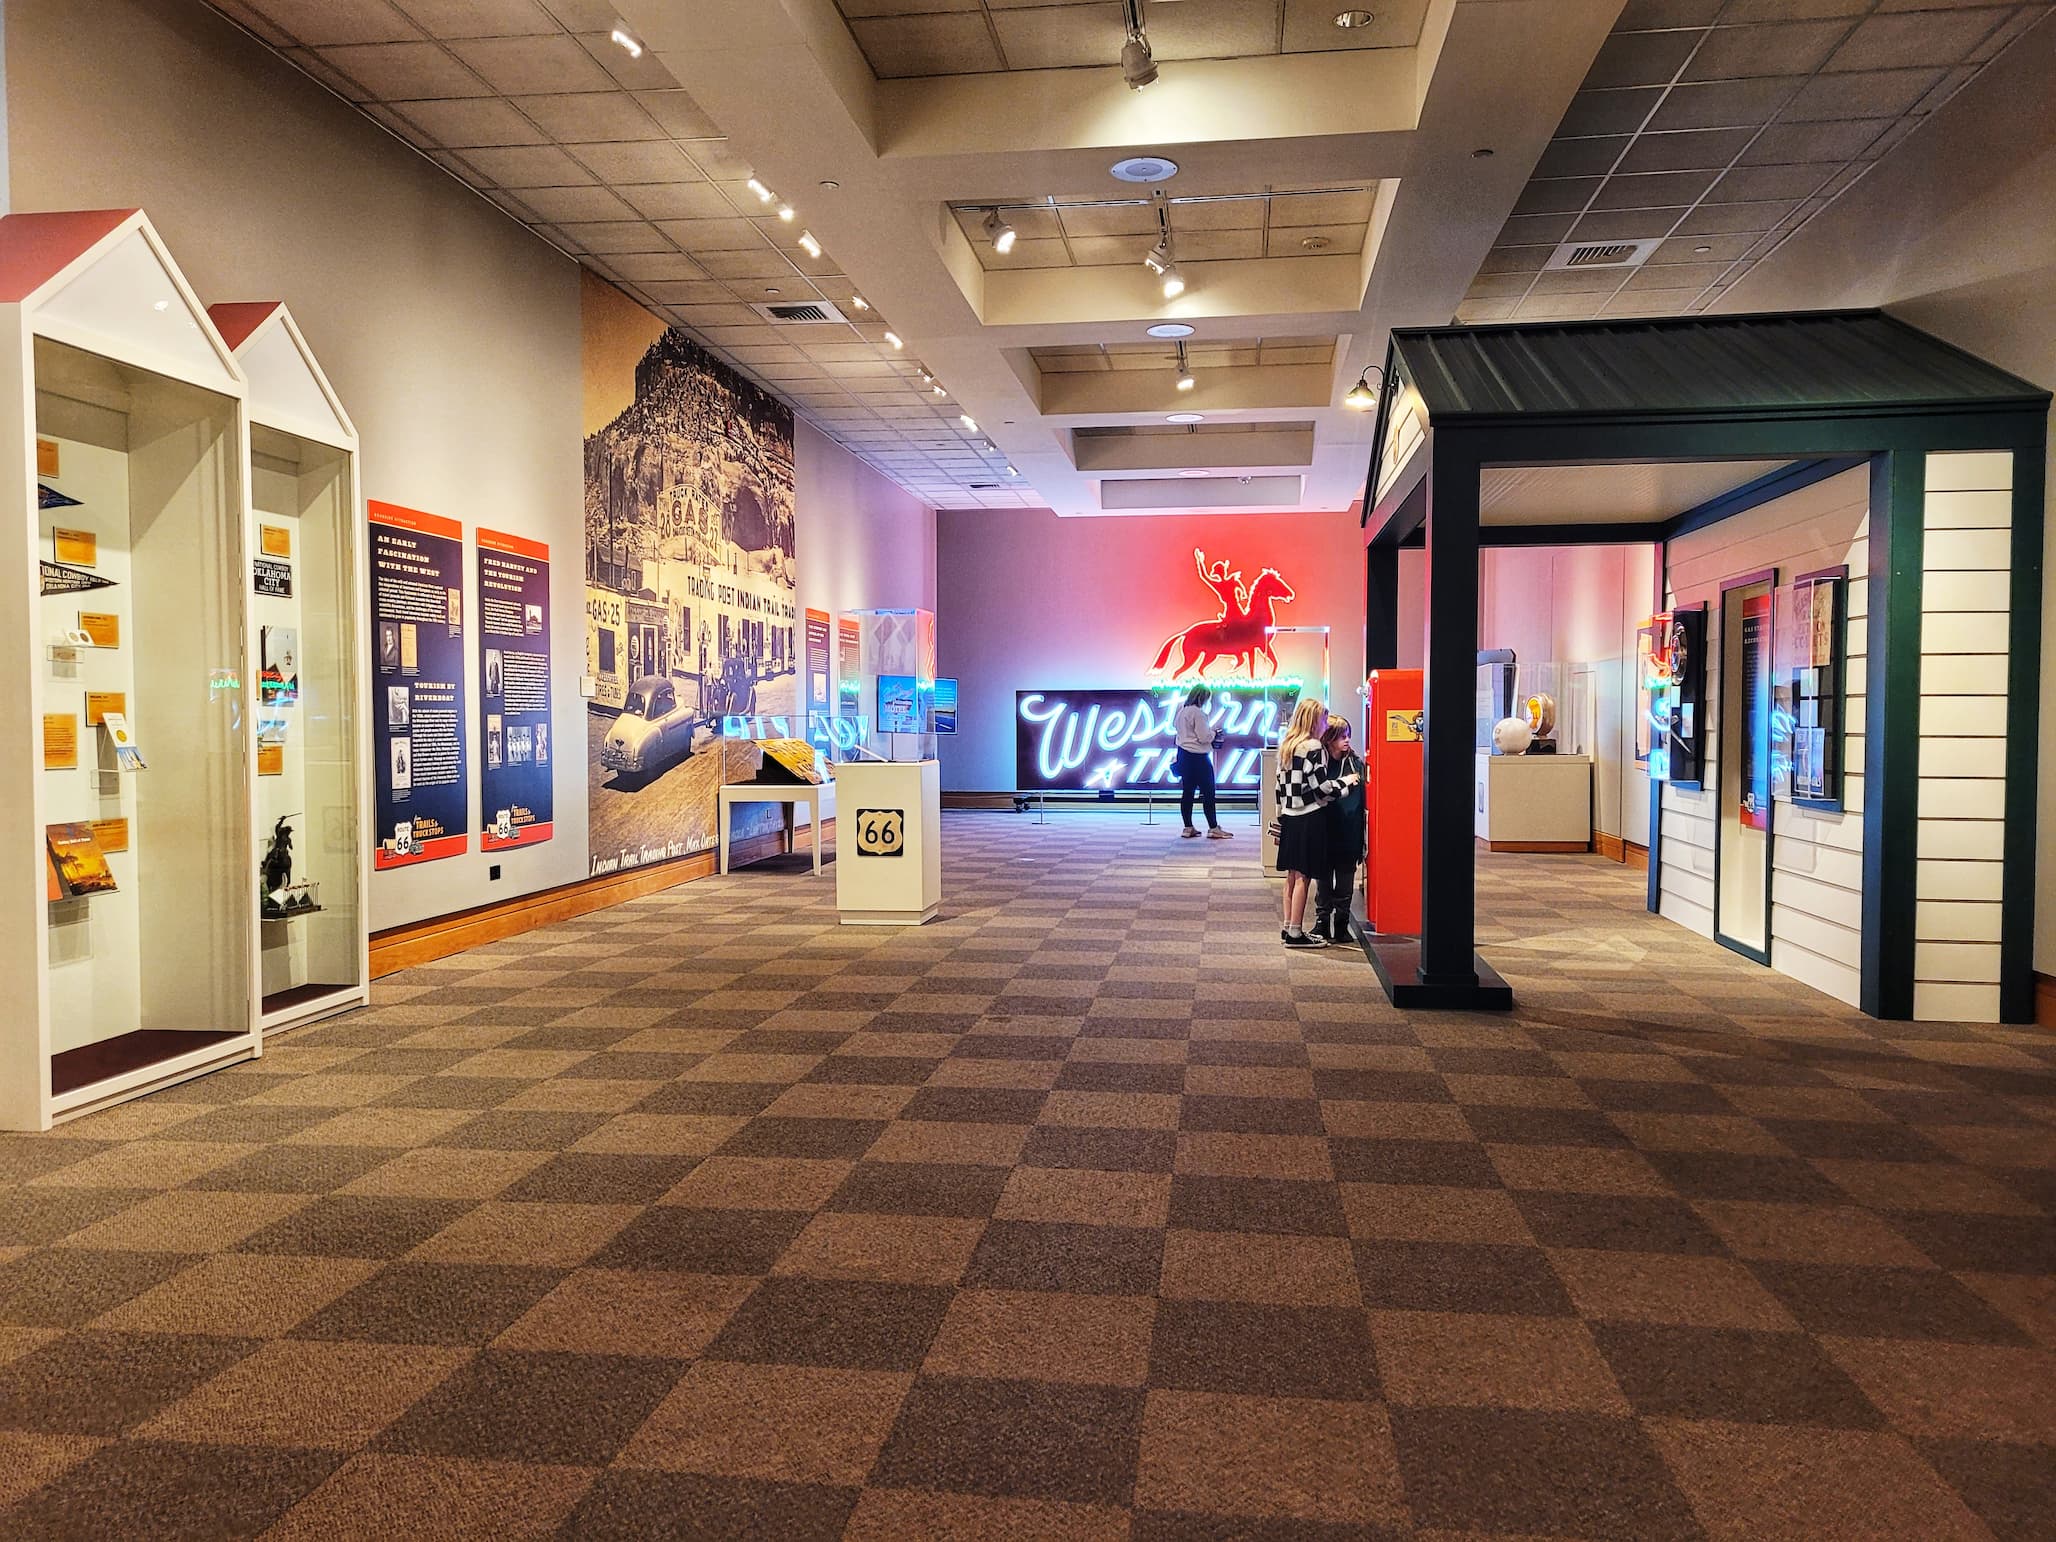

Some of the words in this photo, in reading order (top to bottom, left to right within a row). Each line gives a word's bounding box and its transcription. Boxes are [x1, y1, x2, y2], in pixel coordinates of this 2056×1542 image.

[672, 499, 709, 535] GAS
[377, 535, 390, 543] AN
[391, 537, 417, 549] EARLY
[377, 547, 430, 563] FASCINATION
[254, 566, 290, 580] OKLAHOMA
[377, 560, 402, 571] WITH
[402, 564, 418, 574] THE
[419, 567, 440, 577] WEST
[483, 557, 501, 567] FRED
[501, 561, 525, 572] HARVEY
[525, 566, 538, 574] AND
[263, 577, 281, 587] CITY
[484, 569, 497, 577] THE
[497, 571, 524, 582] TOURISM
[484, 580, 522, 592] REVOLUTION
[687, 575, 715, 601] TRADING
[718, 584, 735, 607] POST
[737, 588, 761, 612] INDIAN
[763, 597, 780, 617] TRAIL
[414, 682, 446, 690] TOURISM
[1019, 688, 1279, 779] Westrn
[1126, 748, 1261, 784] TRIL
[416, 818, 435, 829] TRAILS
[498, 823, 509, 834] 66
[865, 820, 895, 844] 66
[397, 836, 409, 850] 66
[620, 848, 640, 869] TRAIL
